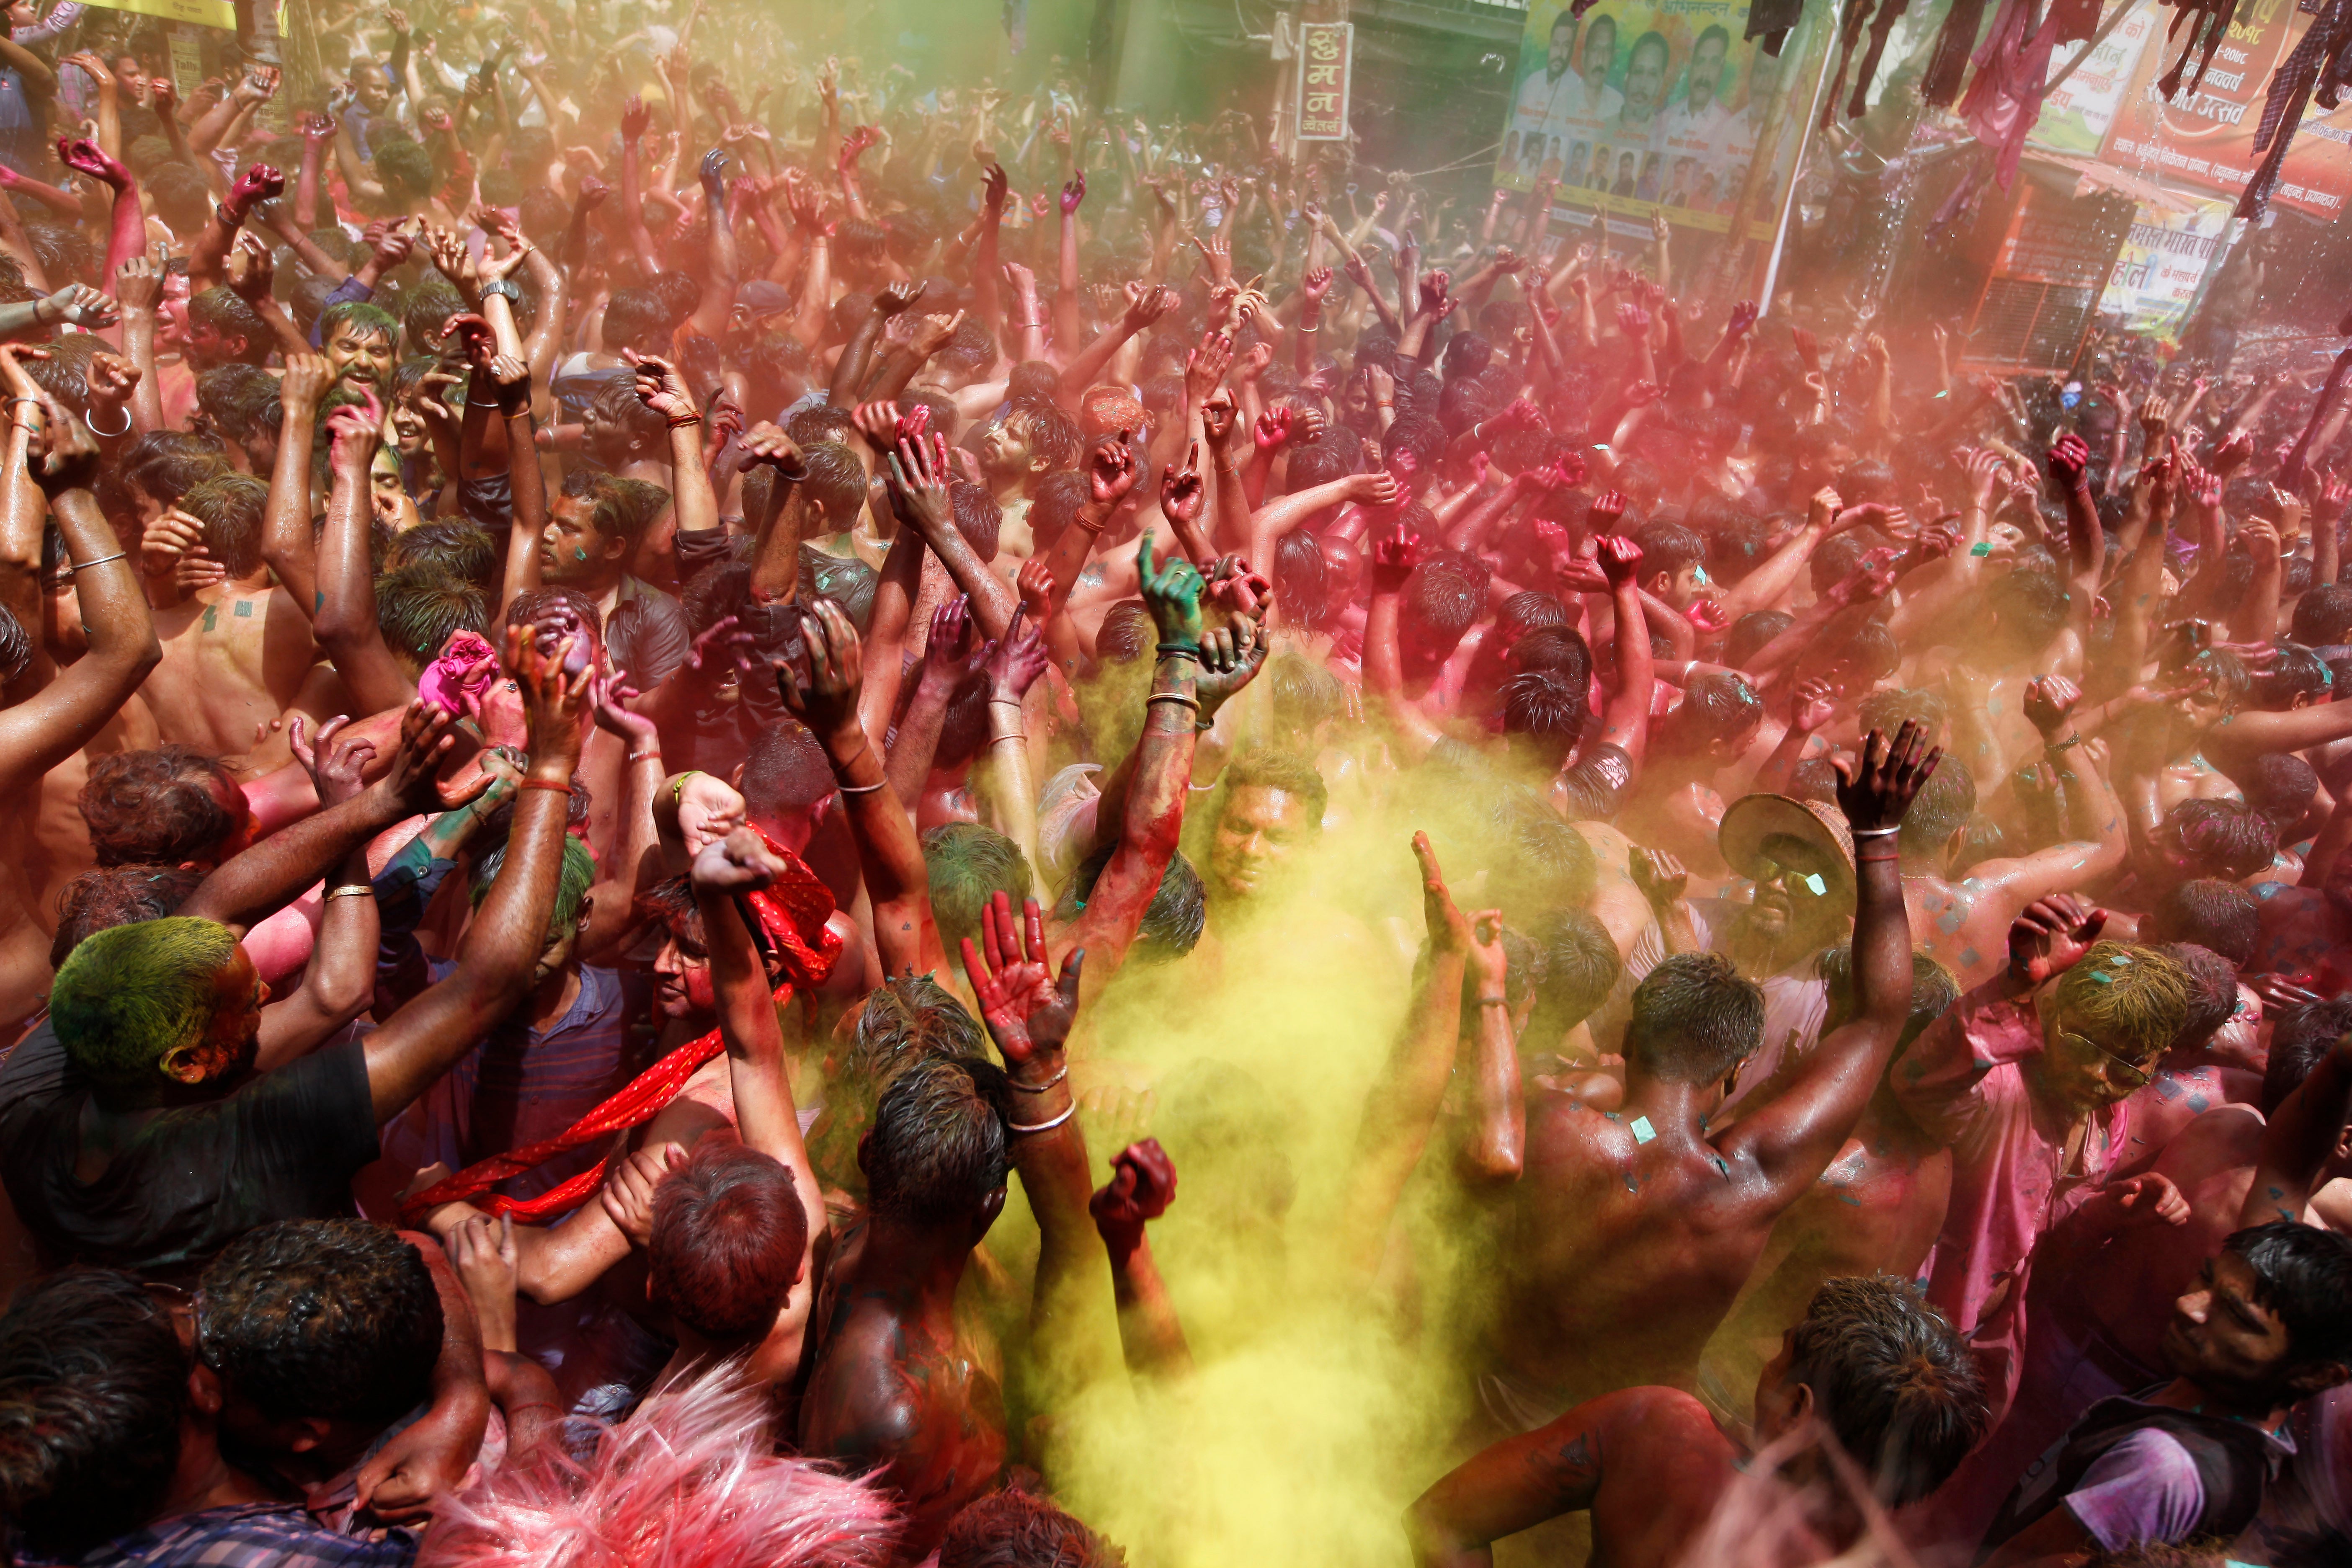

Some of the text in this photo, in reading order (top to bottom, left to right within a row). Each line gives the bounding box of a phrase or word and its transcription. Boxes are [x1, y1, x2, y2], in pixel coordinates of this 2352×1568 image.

[2204, 67, 2245, 93] नववर्ष
[2197, 94, 2248, 126] उत्सव
[2164, 230, 2199, 257] भारत
[2109, 250, 2159, 291] होली
